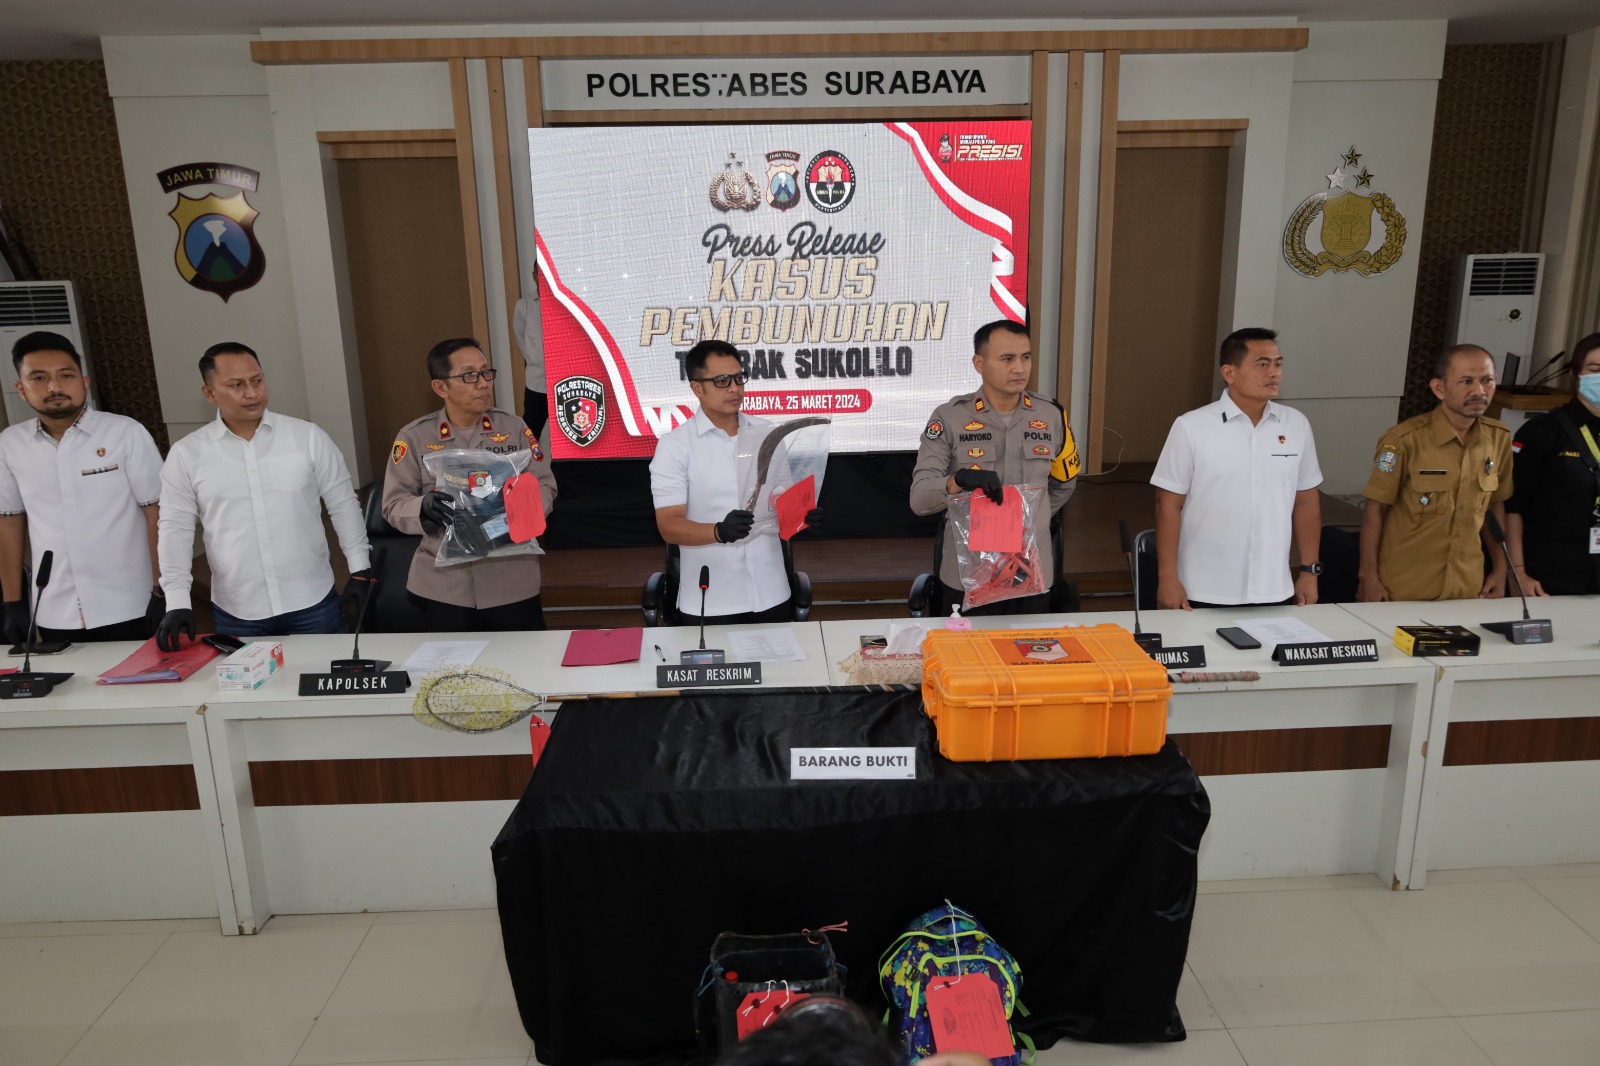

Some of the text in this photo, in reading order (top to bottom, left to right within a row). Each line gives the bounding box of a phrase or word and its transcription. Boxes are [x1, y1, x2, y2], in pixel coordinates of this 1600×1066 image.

[586, 69, 987, 98] POLRESABES SURABAYA
[957, 144, 1023, 159] PRESISI
[166, 168, 251, 186] JAWA TIMUR
[702, 221, 886, 263] Press Release
[707, 256, 878, 301] KASUS
[638, 300, 949, 347] PEMBUNUHAN
[675, 349, 787, 381] TBAK
[557, 380, 602, 396] POLRESTABES
[786, 395, 799, 409] 25
[801, 394, 833, 409] MARET
[835, 393, 861, 408] 2024
[959, 432, 993, 443] HARYOKO
[1024, 431, 1052, 442] POLRI
[1154, 651, 1190, 665] HUMAS
[1284, 644, 1376, 661] WAKASAT RESKRIM
[666, 667, 752, 683] KASAT RESKRIM
[317, 676, 388, 691] KAPOLSEK
[798, 755, 908, 767] BARANG BUKTI
